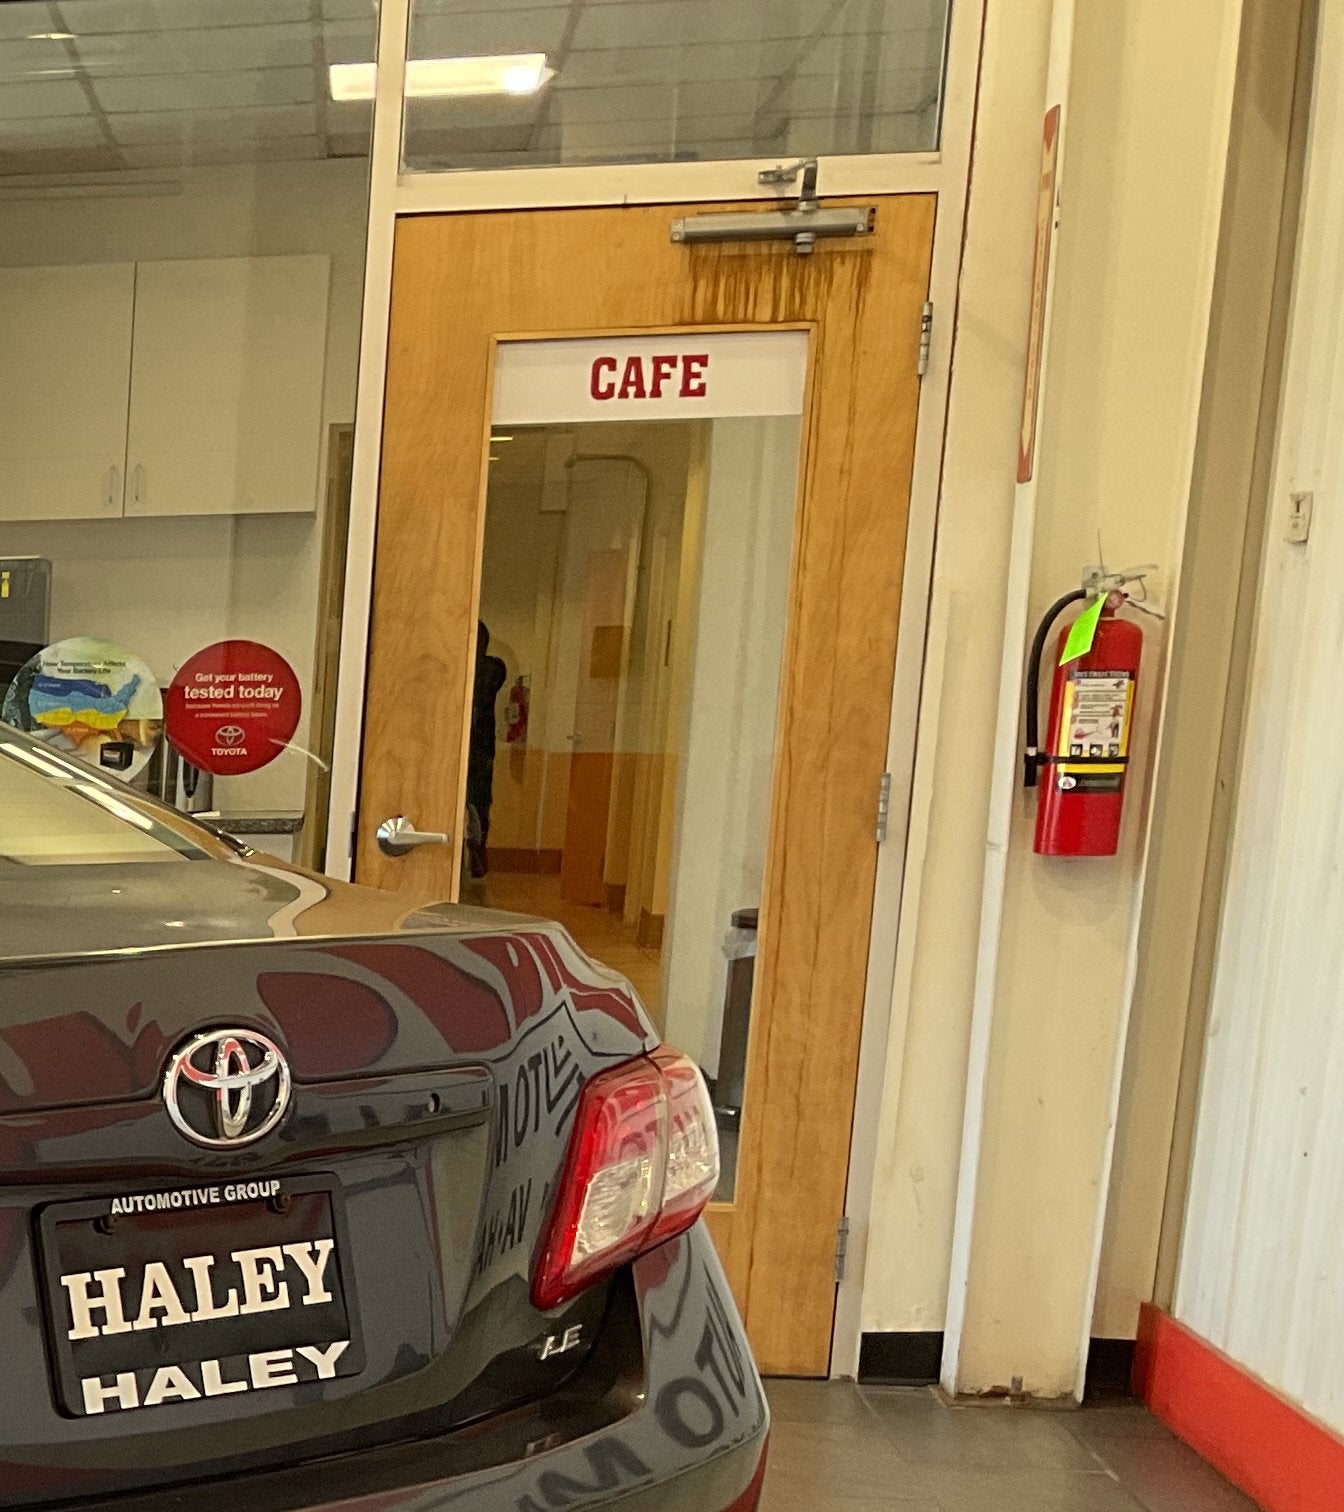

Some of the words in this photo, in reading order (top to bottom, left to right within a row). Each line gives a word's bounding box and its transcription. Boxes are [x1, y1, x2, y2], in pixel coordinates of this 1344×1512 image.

[590, 354, 709, 401] CAFE
[184, 685, 234, 699] tested
[238, 685, 283, 701] today
[195, 673, 213, 682] Get
[214, 674, 236, 683] your
[238, 673, 273, 682] battery
[211, 748, 247, 756] TOYOTA
[111, 1186, 220, 1215] AUTOMOTIVE
[224, 1180, 280, 1201] GROUP
[61, 1239, 334, 1339] HALEY
[540, 1324, 583, 1360] LE
[81, 1341, 350, 1414] HALEY
